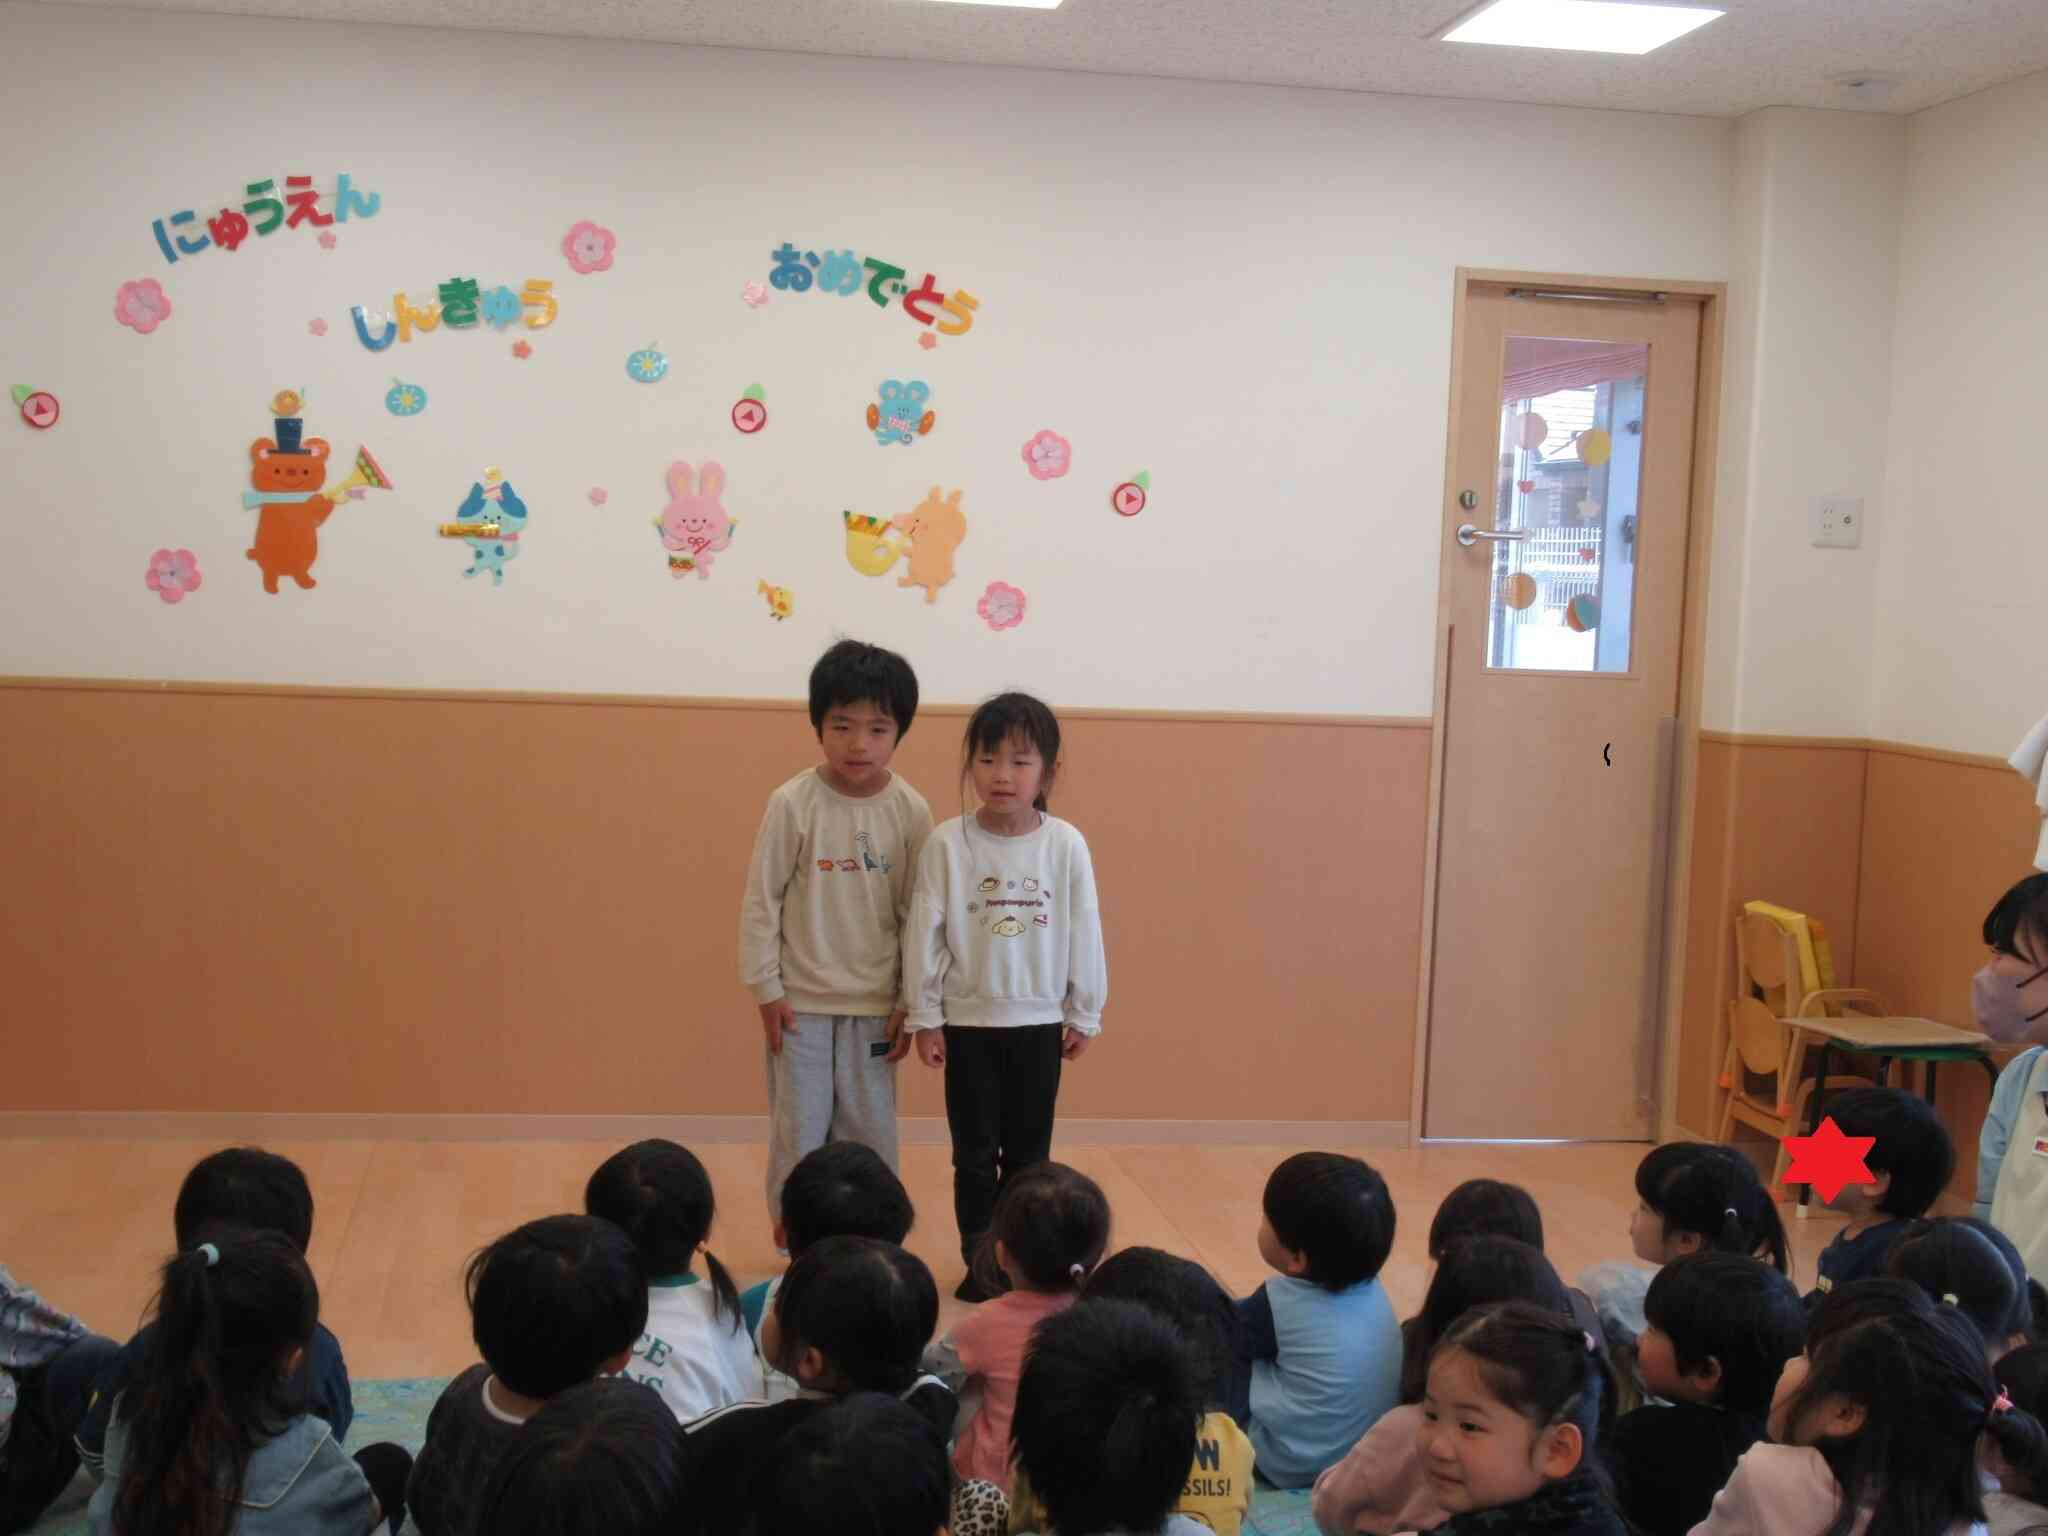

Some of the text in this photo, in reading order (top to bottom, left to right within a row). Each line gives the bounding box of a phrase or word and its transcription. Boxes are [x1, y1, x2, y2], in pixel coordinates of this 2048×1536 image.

[152, 173, 380, 265] にゅうえん
[350, 277, 558, 353] しんきゅう
[769, 242, 979, 336] おめでとう
